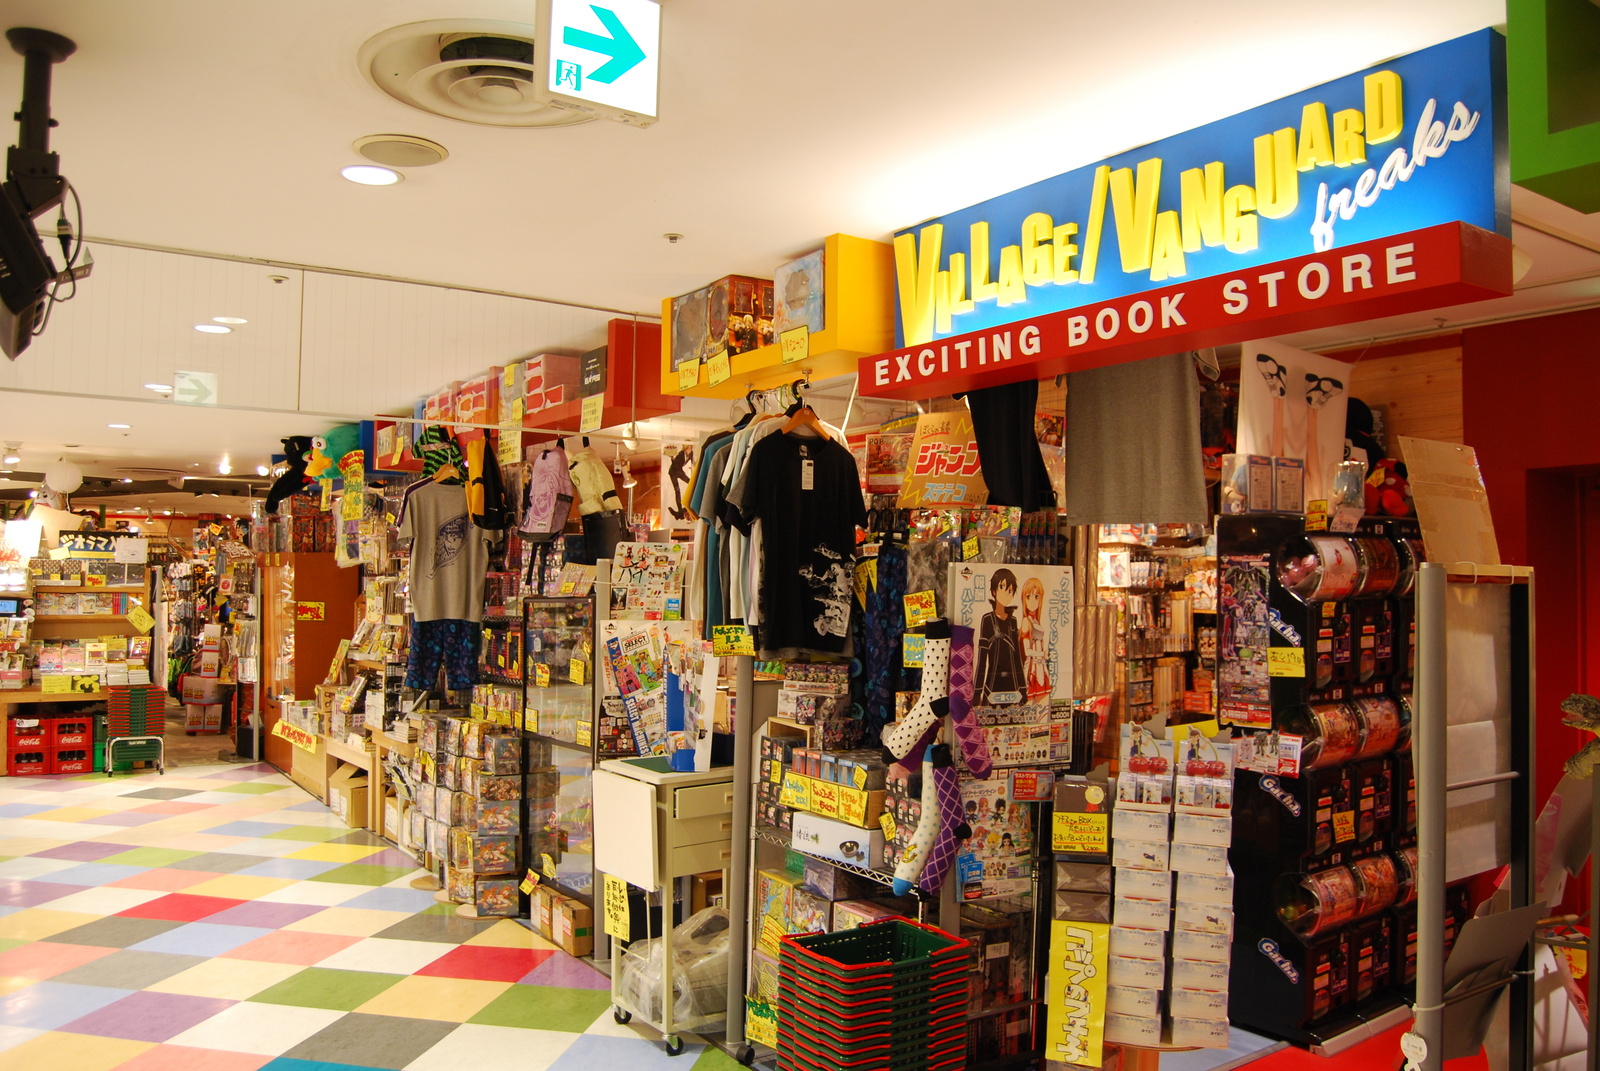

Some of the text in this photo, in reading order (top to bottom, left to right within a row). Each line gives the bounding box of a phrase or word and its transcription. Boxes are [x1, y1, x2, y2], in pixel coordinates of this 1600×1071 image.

[1309, 98, 1480, 249] freaks
[873, 242, 1418, 387] EXCITING BOOK STORE
[624, 636, 647, 649] SELECT
[1060, 577, 1070, 626] クエスト
